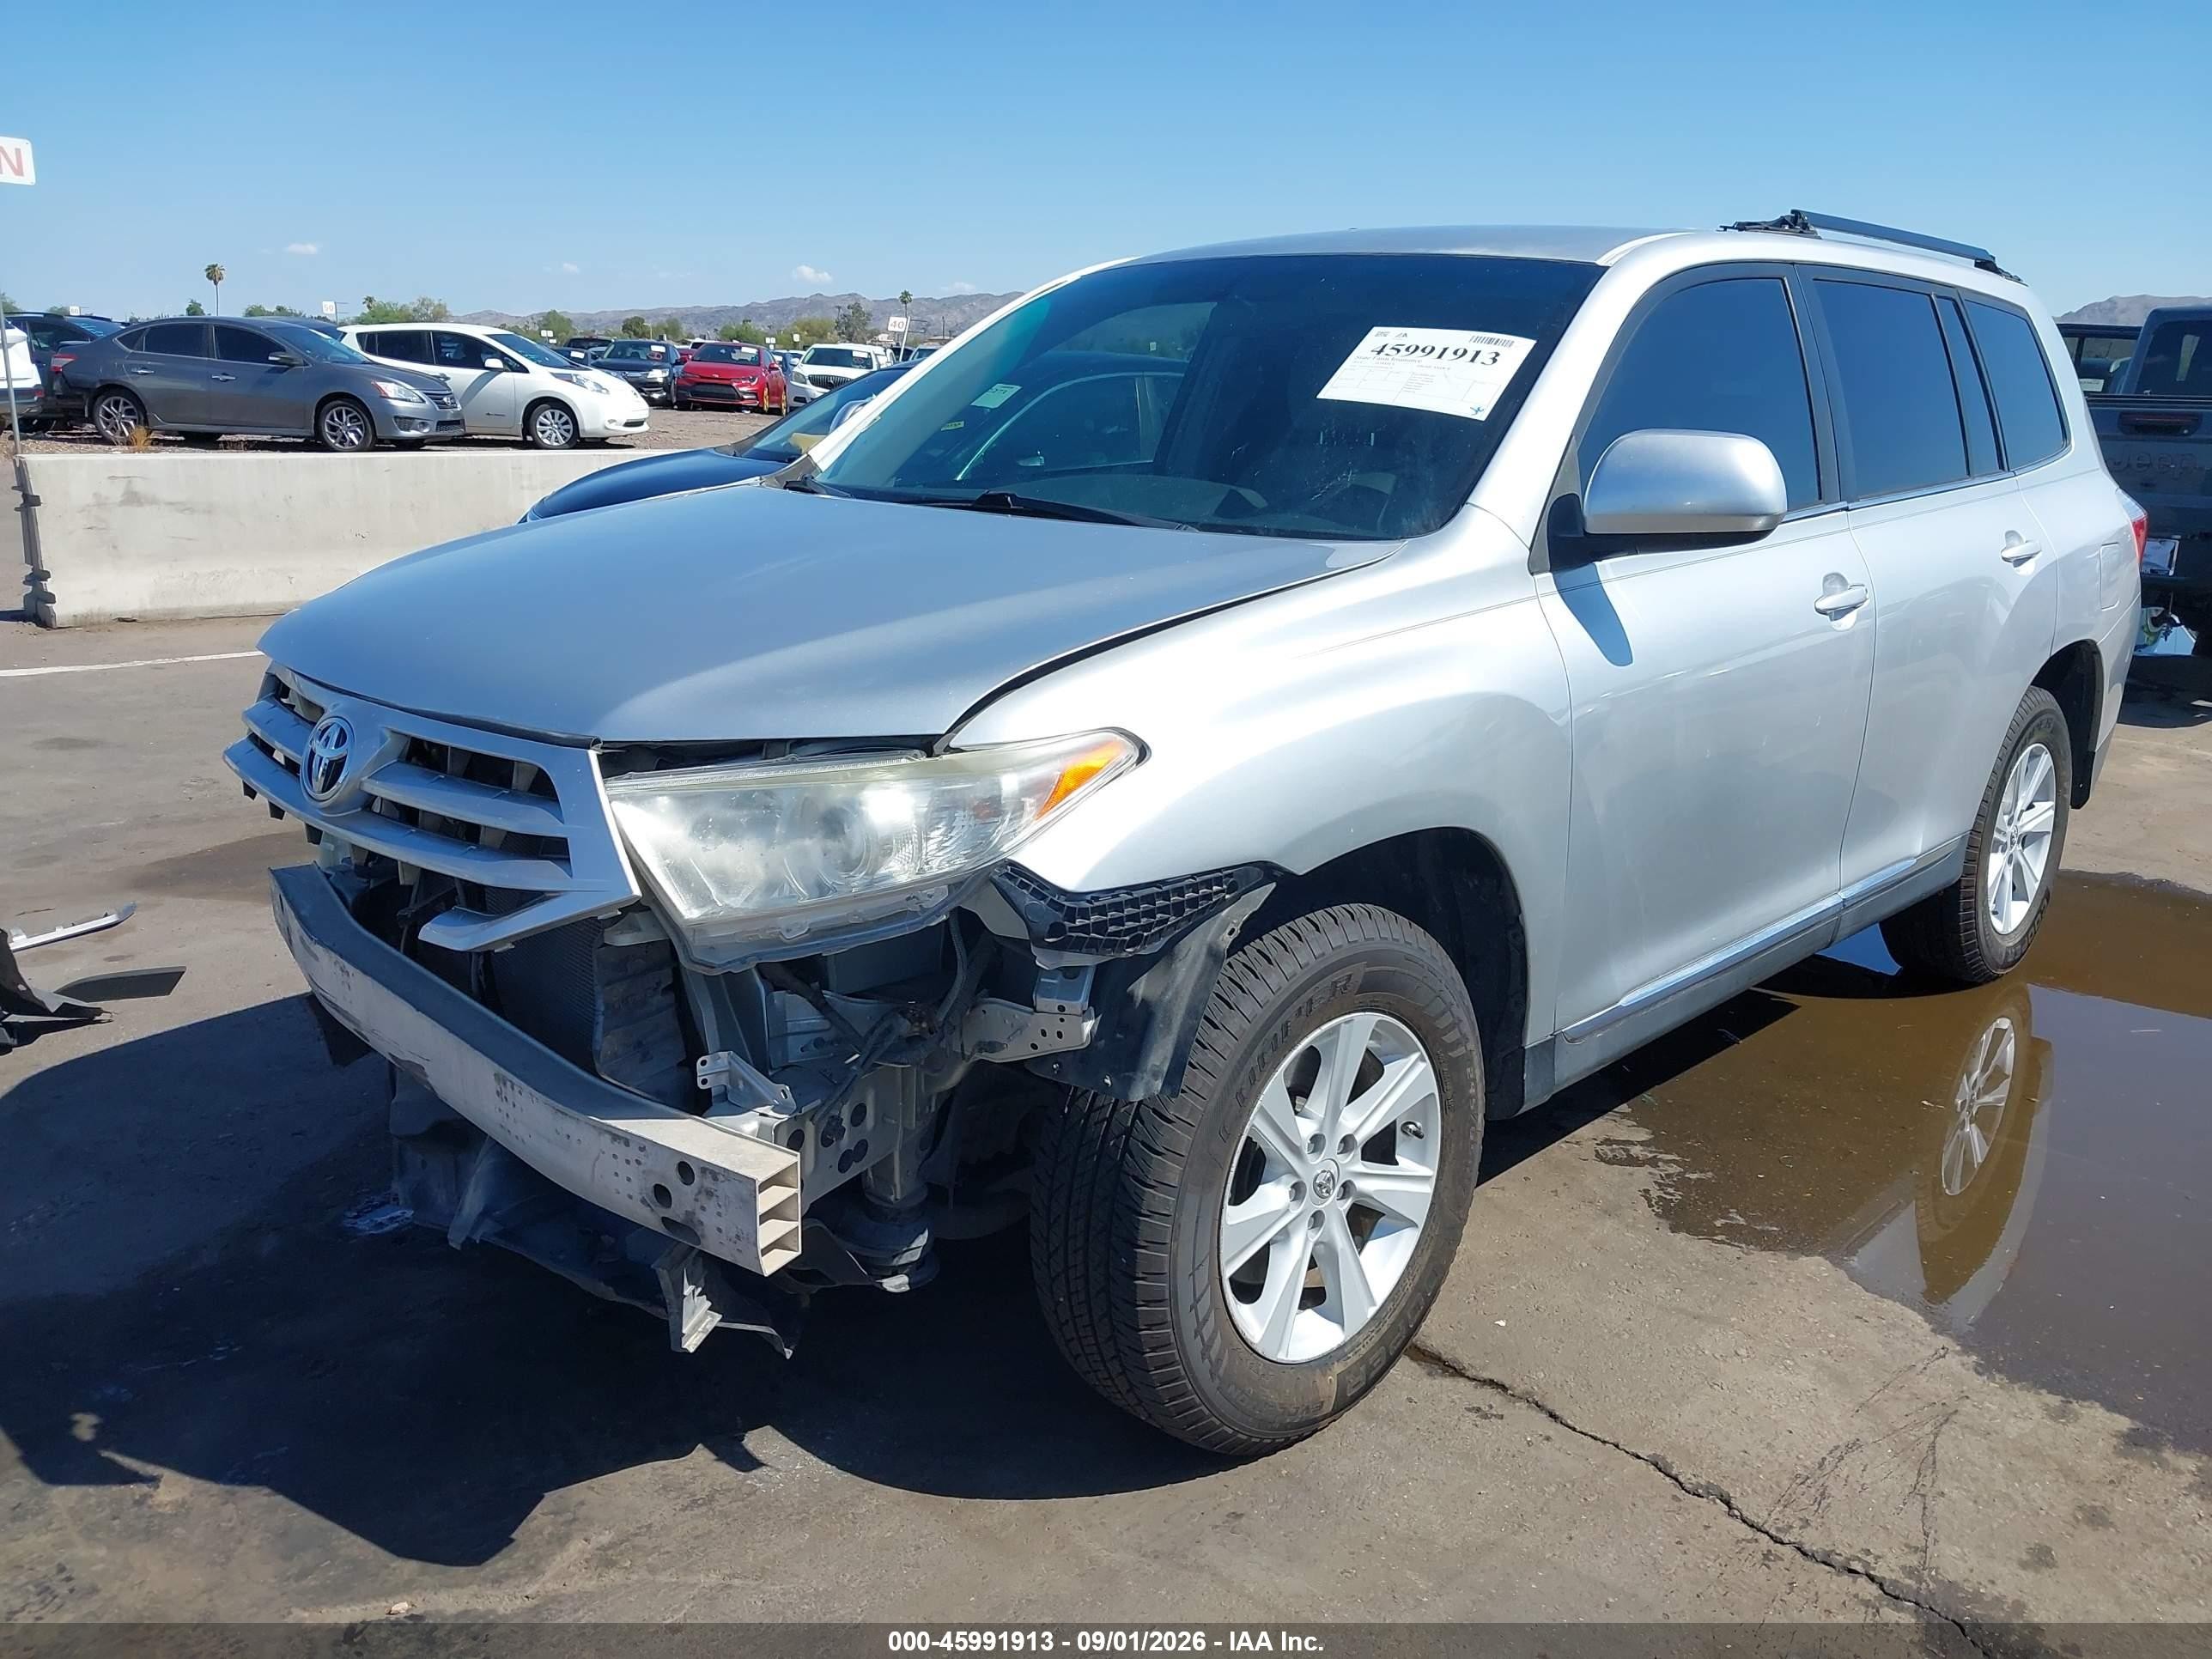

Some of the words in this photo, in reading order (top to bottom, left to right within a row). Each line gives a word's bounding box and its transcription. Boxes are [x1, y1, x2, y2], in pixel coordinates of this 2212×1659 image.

[890, 320, 905, 329] 40
[1370, 343, 1501, 366] 45991913
[2106, 443, 2200, 481] Jeep
